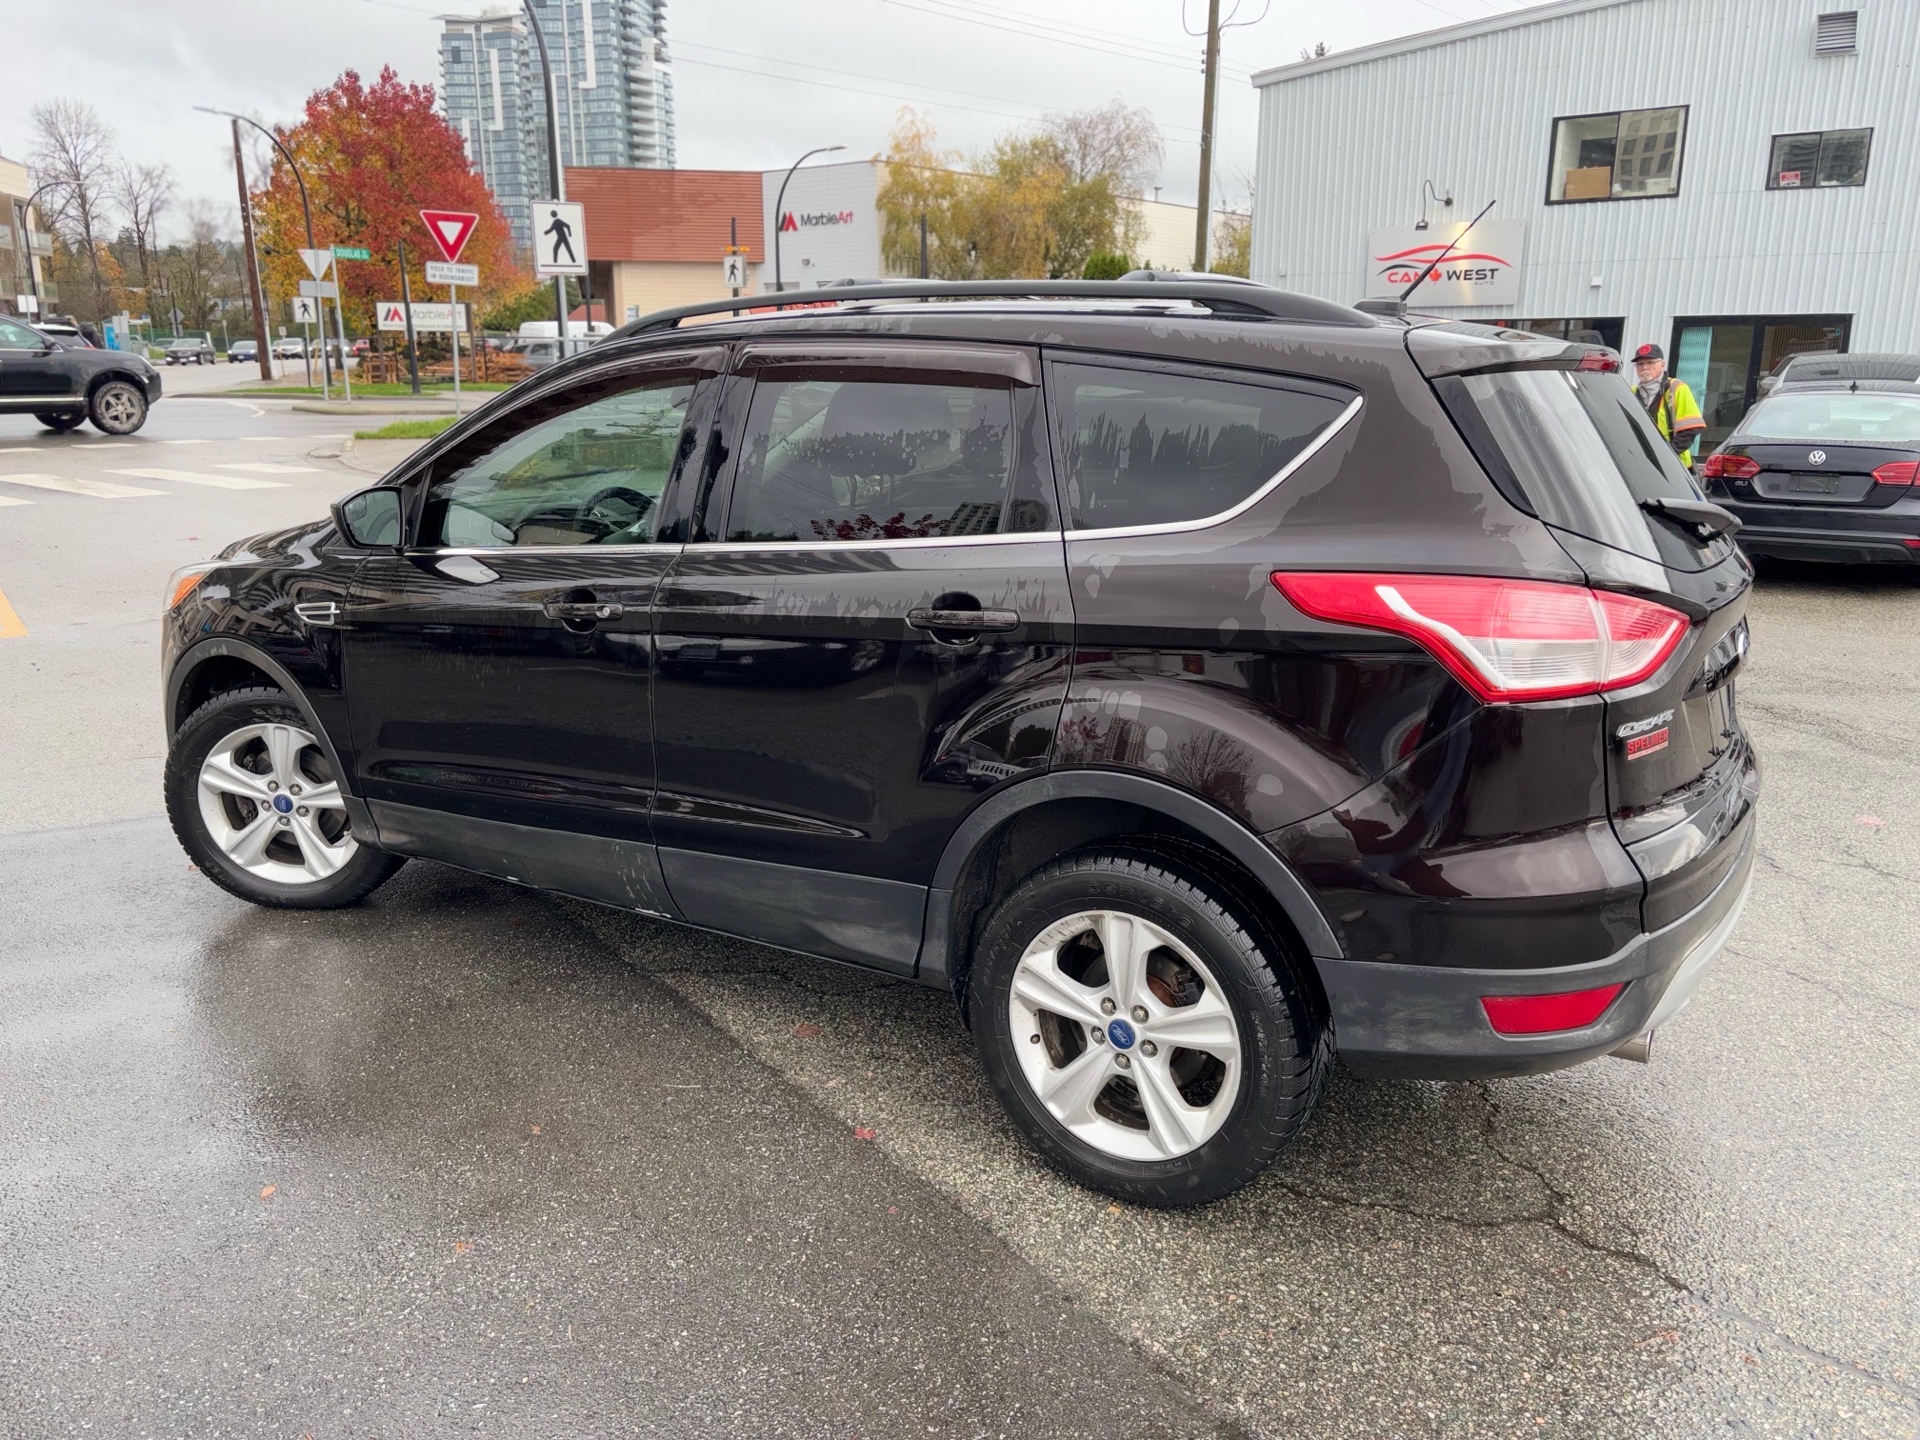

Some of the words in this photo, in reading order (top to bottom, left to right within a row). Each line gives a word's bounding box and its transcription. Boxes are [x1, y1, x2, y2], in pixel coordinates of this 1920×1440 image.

[800, 210, 854, 227] MarbleArt
[335, 248, 361, 259] DOUGLAS
[439, 273, 475, 282] ROUNDABOUT
[454, 267, 475, 275] TRAFFIC
[1446, 268, 1500, 281] WEST
[1627, 730, 1669, 754] SPELMER
[1111, 1026, 1129, 1044] Ford
